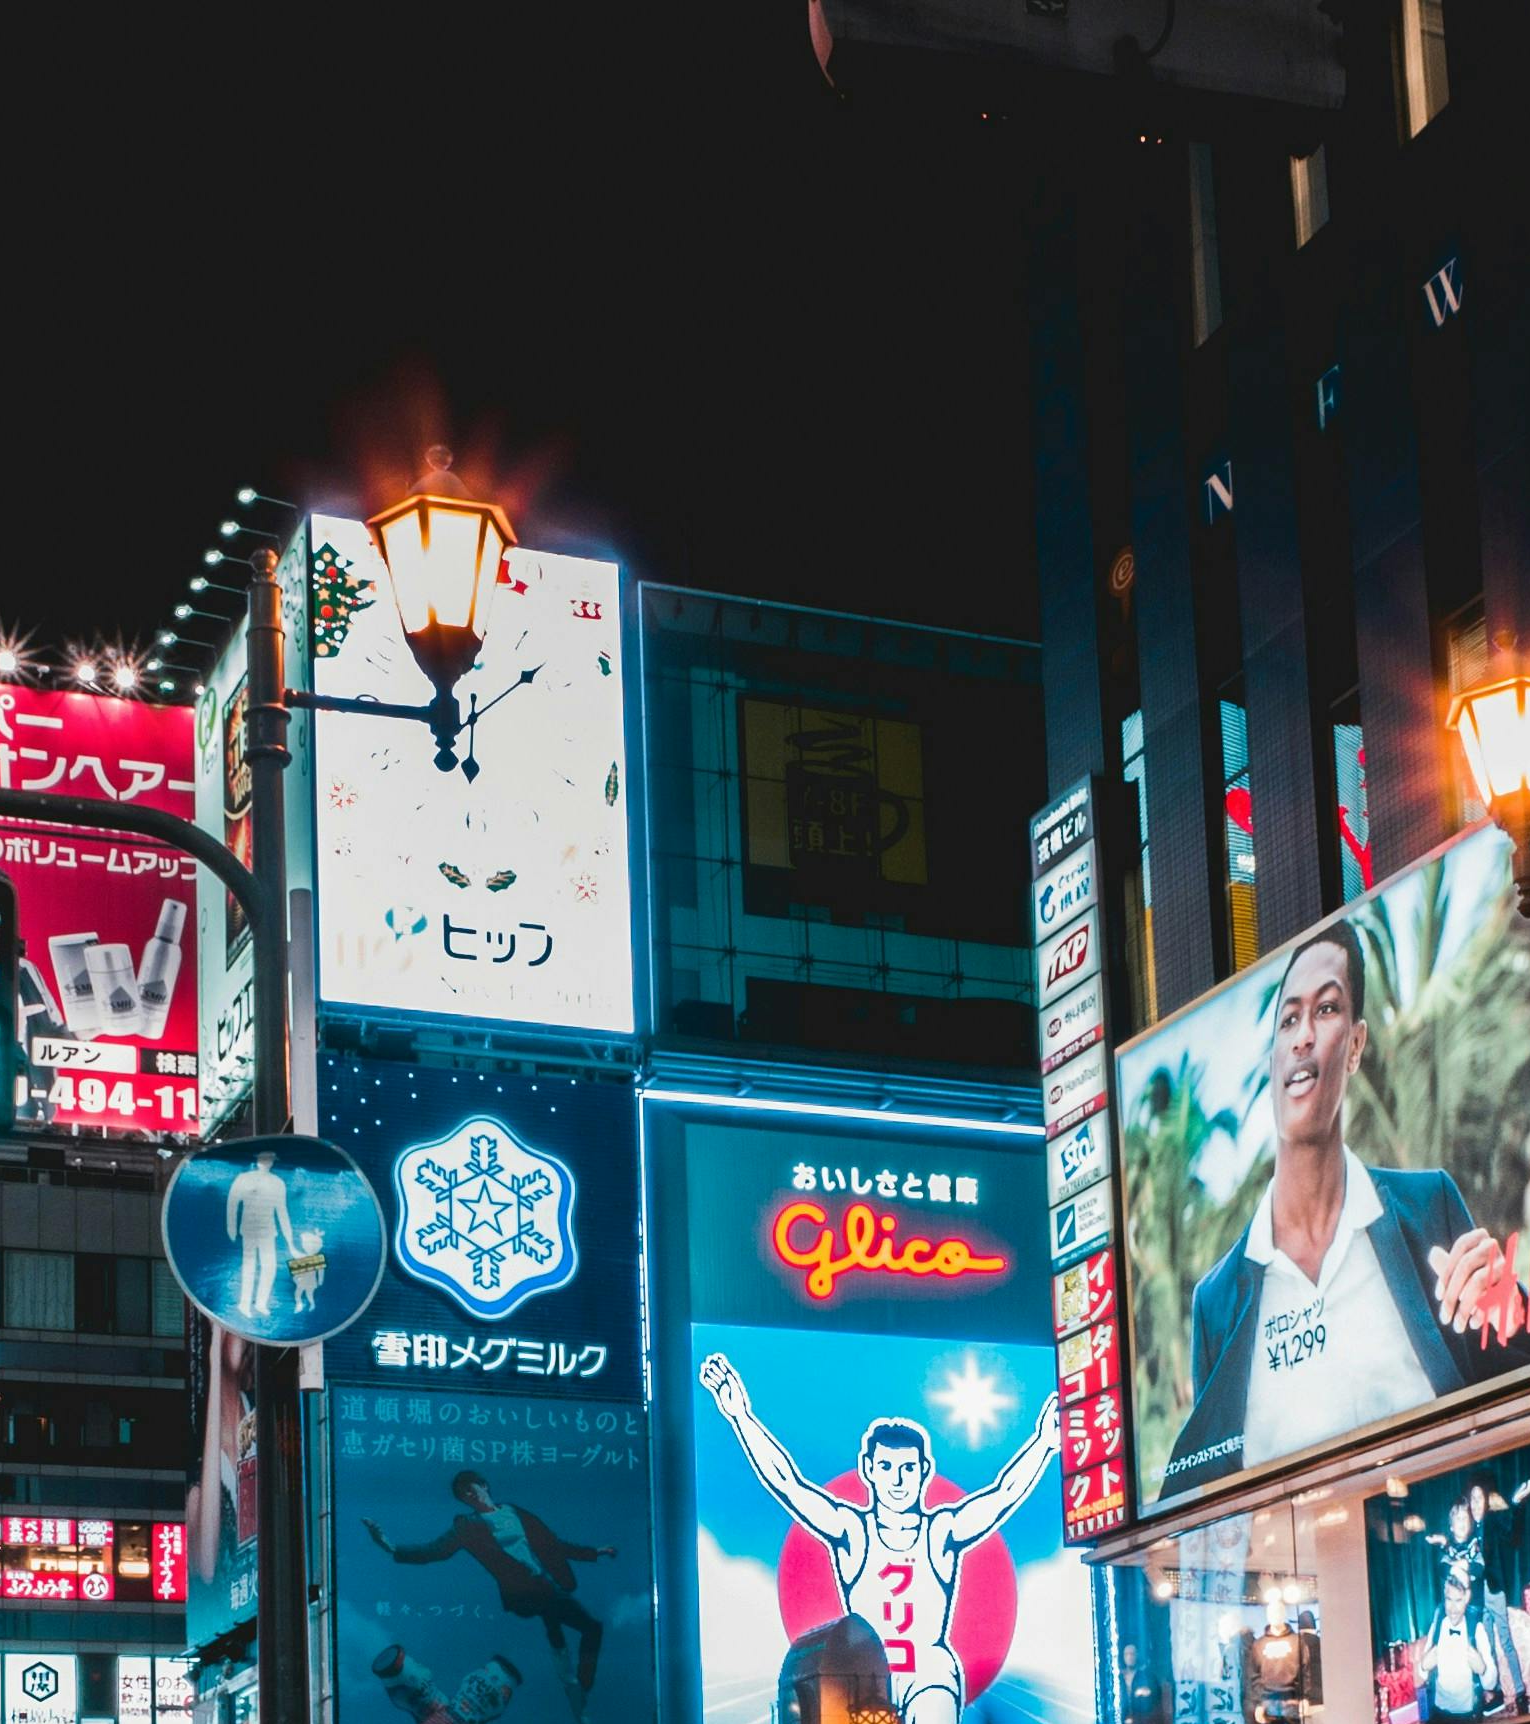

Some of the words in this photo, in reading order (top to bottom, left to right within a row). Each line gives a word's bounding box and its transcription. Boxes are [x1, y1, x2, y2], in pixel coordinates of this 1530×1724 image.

[40, 1044, 102, 1064] ルアン
[792, 1162, 979, 1207] おいしさと健康
[1265, 1297, 1325, 1339] ポロシャツ
[372, 1330, 607, 1378] 雪印メグミルク
[1266, 1323, 1327, 1372] ¥1,299
[1087, 1250, 1123, 1498] インターネット
[340, 1394, 639, 1437] 道頓堀のおいしいものと
[1063, 1375, 1093, 1511] コミック
[6, 1578, 74, 1600] ふうふう亭
